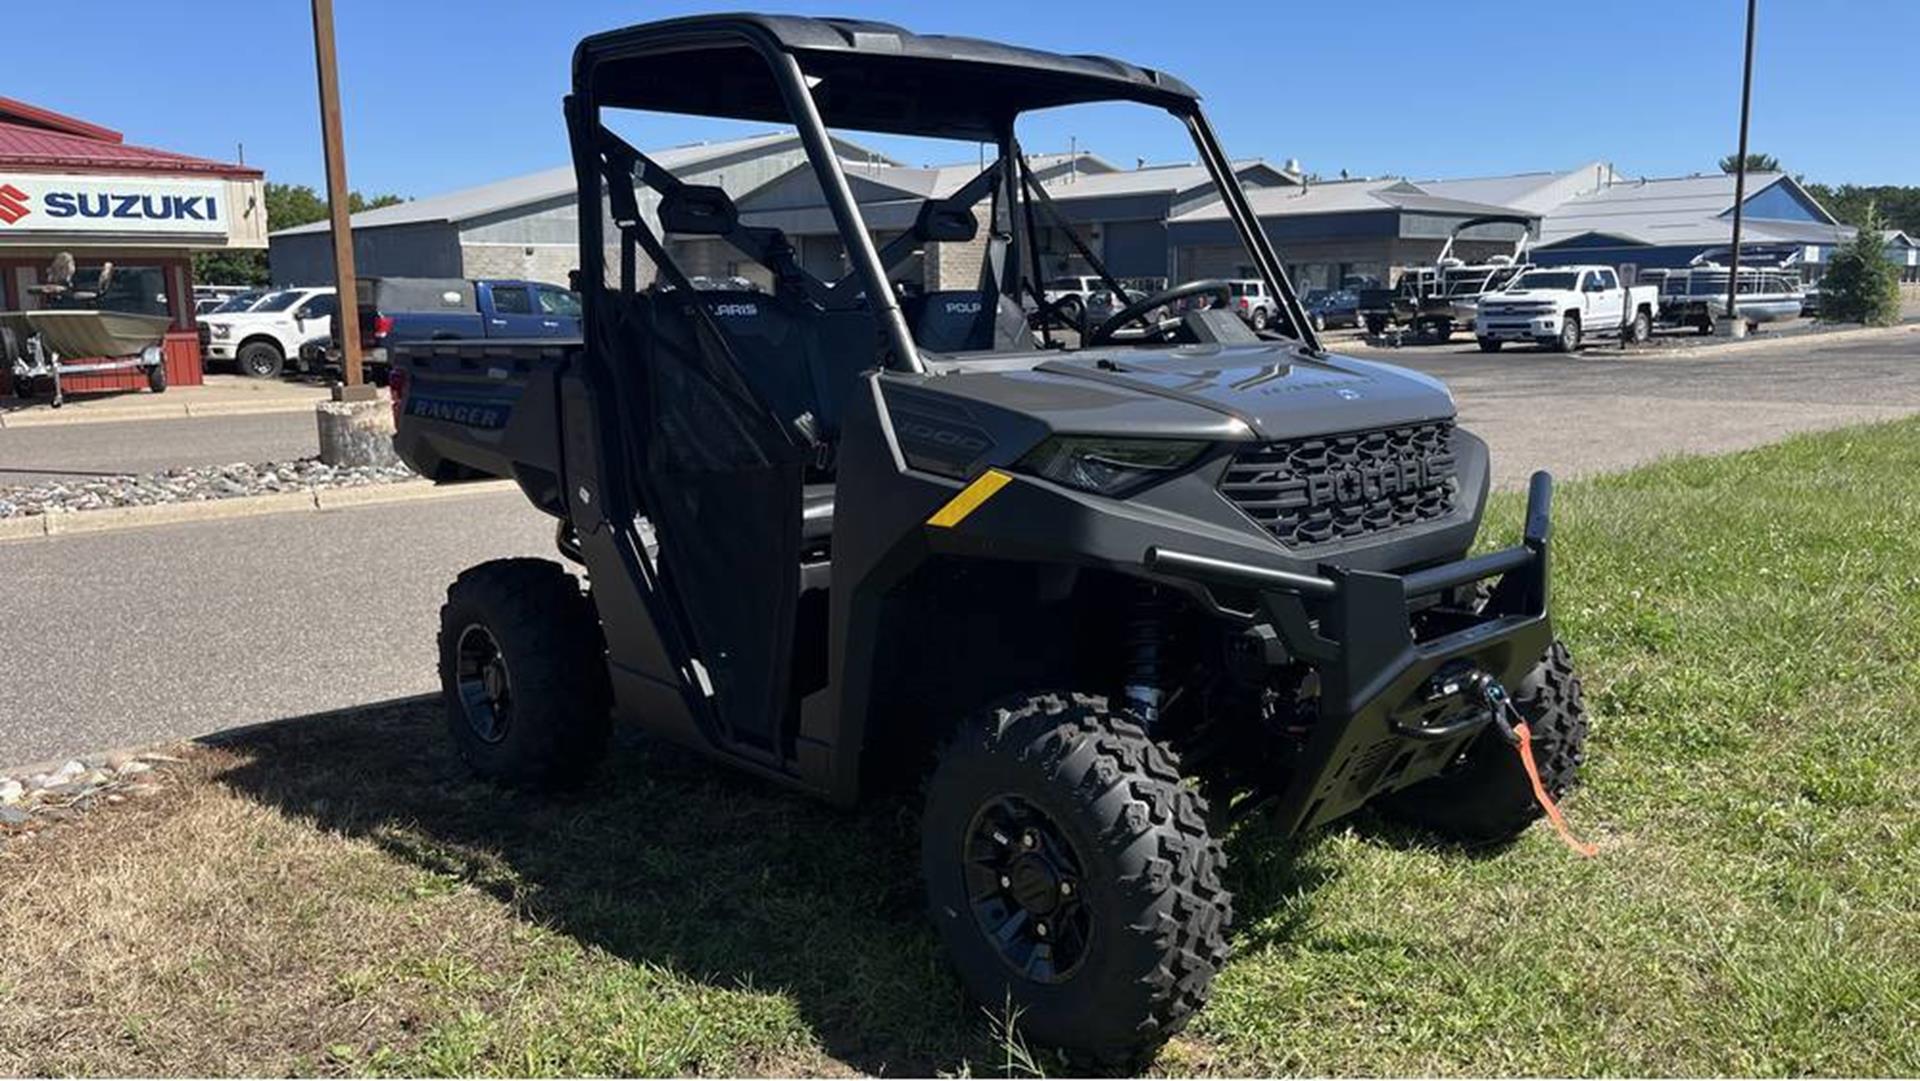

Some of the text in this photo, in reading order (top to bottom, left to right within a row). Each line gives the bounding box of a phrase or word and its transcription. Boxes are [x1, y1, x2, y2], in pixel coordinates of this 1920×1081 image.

[44, 192, 217, 221] SUZUKI
[414, 399, 500, 427] RANGER
[1308, 452, 1457, 506] POLARIS
